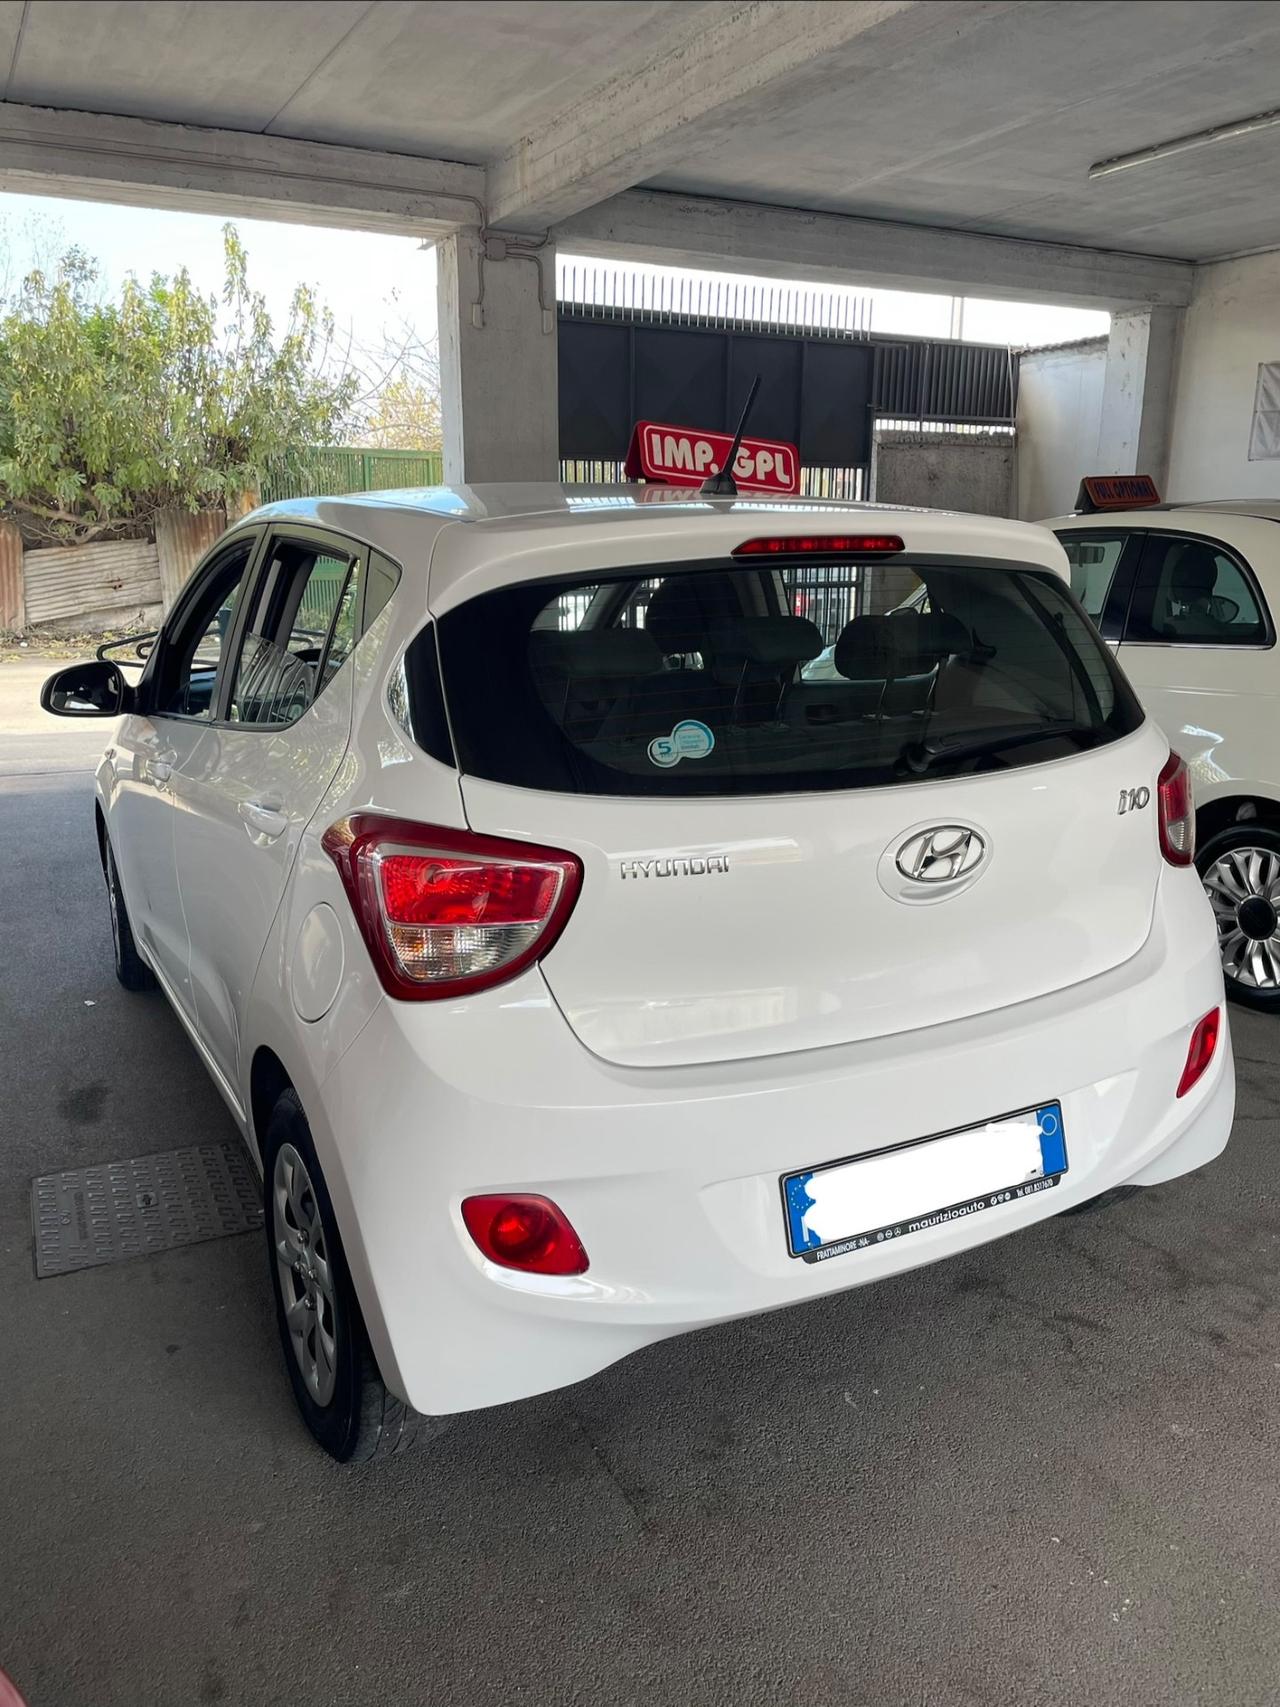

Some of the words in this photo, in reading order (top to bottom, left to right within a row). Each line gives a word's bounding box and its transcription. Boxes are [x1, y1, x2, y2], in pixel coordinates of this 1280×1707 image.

[651, 433, 720, 474] IMP.
[731, 446, 791, 484] GPL
[657, 741, 672, 755] 5
[1117, 786, 1150, 815] i10
[621, 855, 729, 879] HYUNDAI
[816, 1240, 858, 1260] FRATTAMINORE
[908, 1200, 986, 1232] maurizioauto
